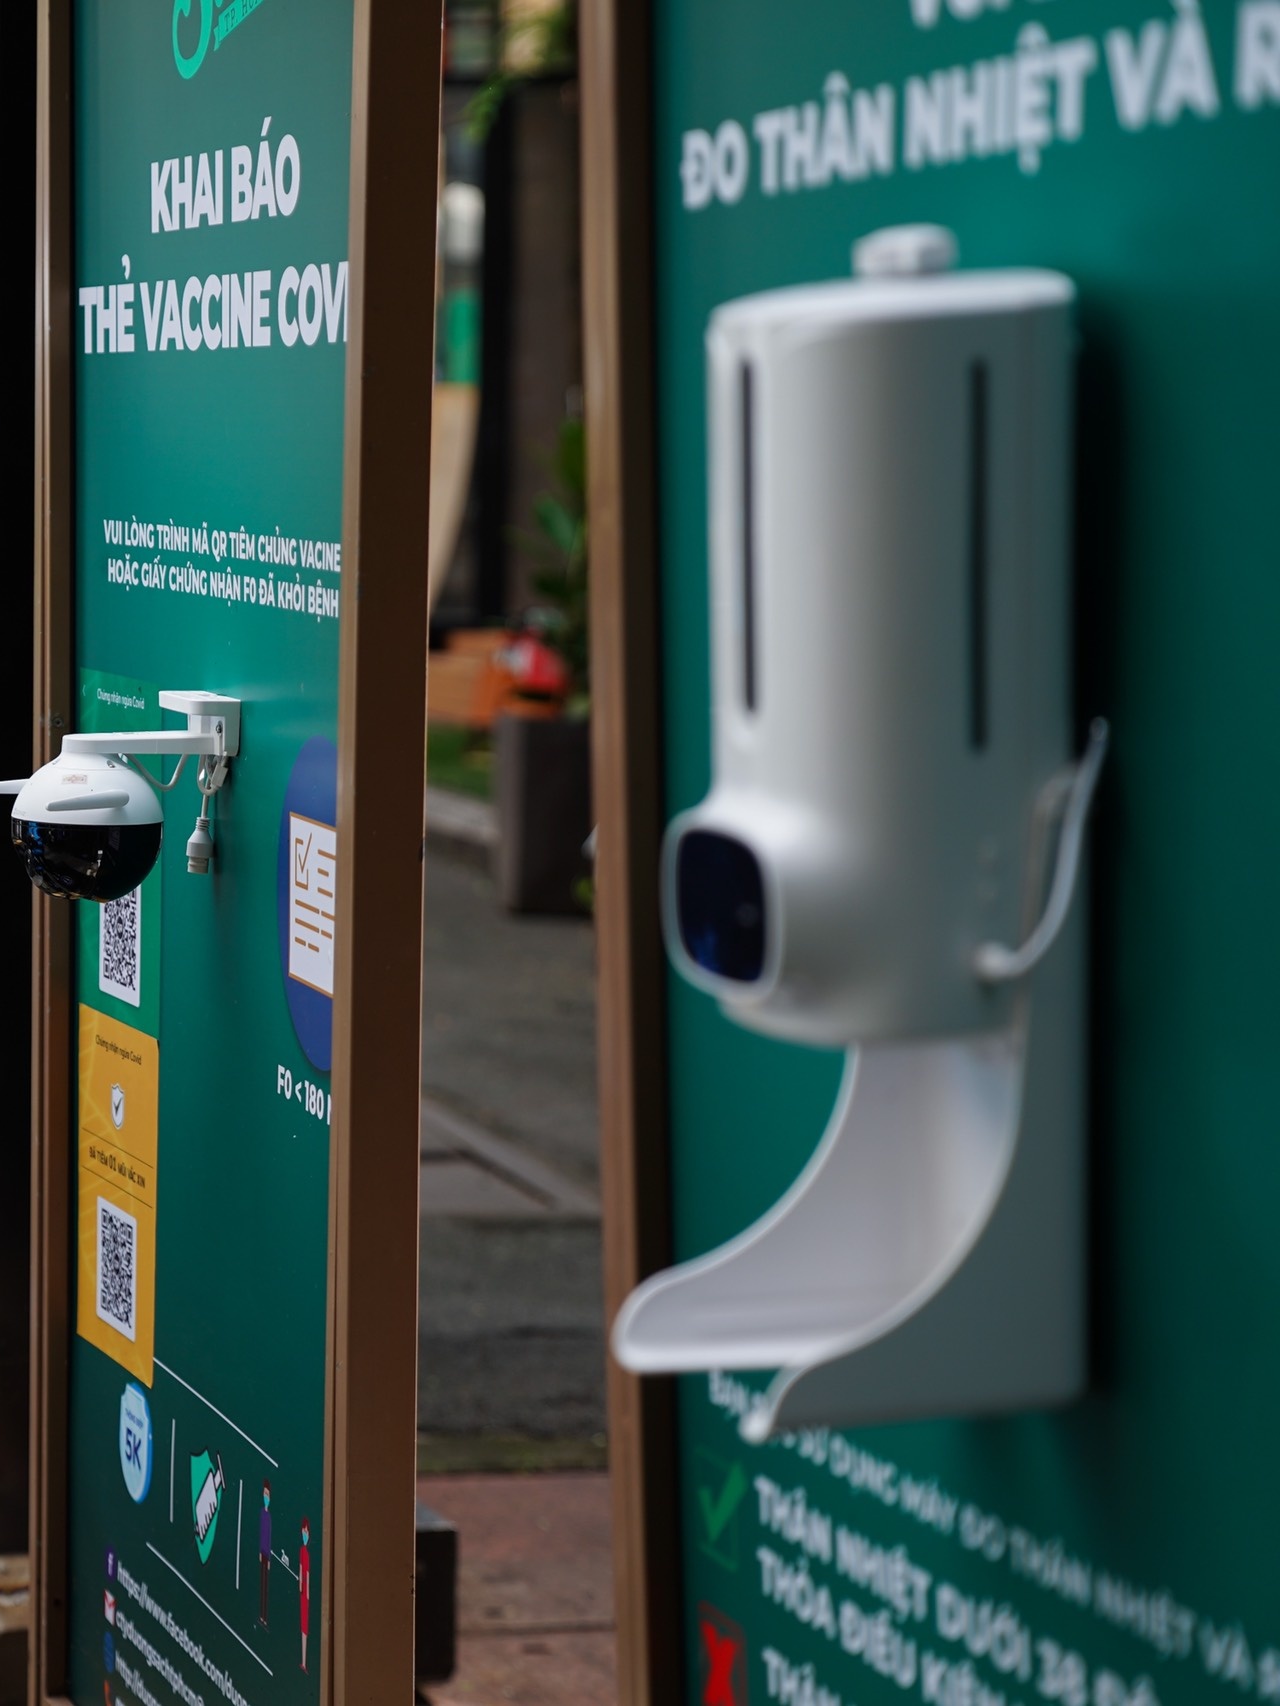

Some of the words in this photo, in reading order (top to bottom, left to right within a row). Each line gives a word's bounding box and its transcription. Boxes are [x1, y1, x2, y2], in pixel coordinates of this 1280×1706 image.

[681, 120, 748, 210] ĐO
[753, 71, 894, 197] THÂN
[904, 22, 1097, 176] NHIỆT
[151, 149, 223, 234] KHAI
[231, 116, 300, 222] BÁO
[79, 254, 135, 354] THẺ
[139, 270, 271, 351] VACCINE
[103, 519, 122, 545] VUI
[124, 515, 154, 548] LÒNG
[156, 518, 189, 552] TRÌNH
[192, 521, 209, 555] MÃ
[211, 530, 228, 562] QR
[229, 525, 255, 561] TIÊM
[257, 526, 297, 566] CHỦNG
[299, 539, 341, 573] VACINE
[107, 554, 139, 591] HOẶC
[141, 555, 167, 589] GIẤY
[168, 561, 207, 596] CHỨNG
[209, 566, 241, 606] NHẬN
[258, 572, 276, 607] ĐÃ
[277, 573, 305, 612] KHỎI
[307, 579, 339, 622] BỆNH
[304, 1080, 324, 1120] 180
[109, 1154, 116, 1172] 01
[125, 1426, 142, 1471] 5K
[836, 1524, 932, 1623] NHIỆT
[117, 1560, 251, 1706] https://www.facebook.com/duon
